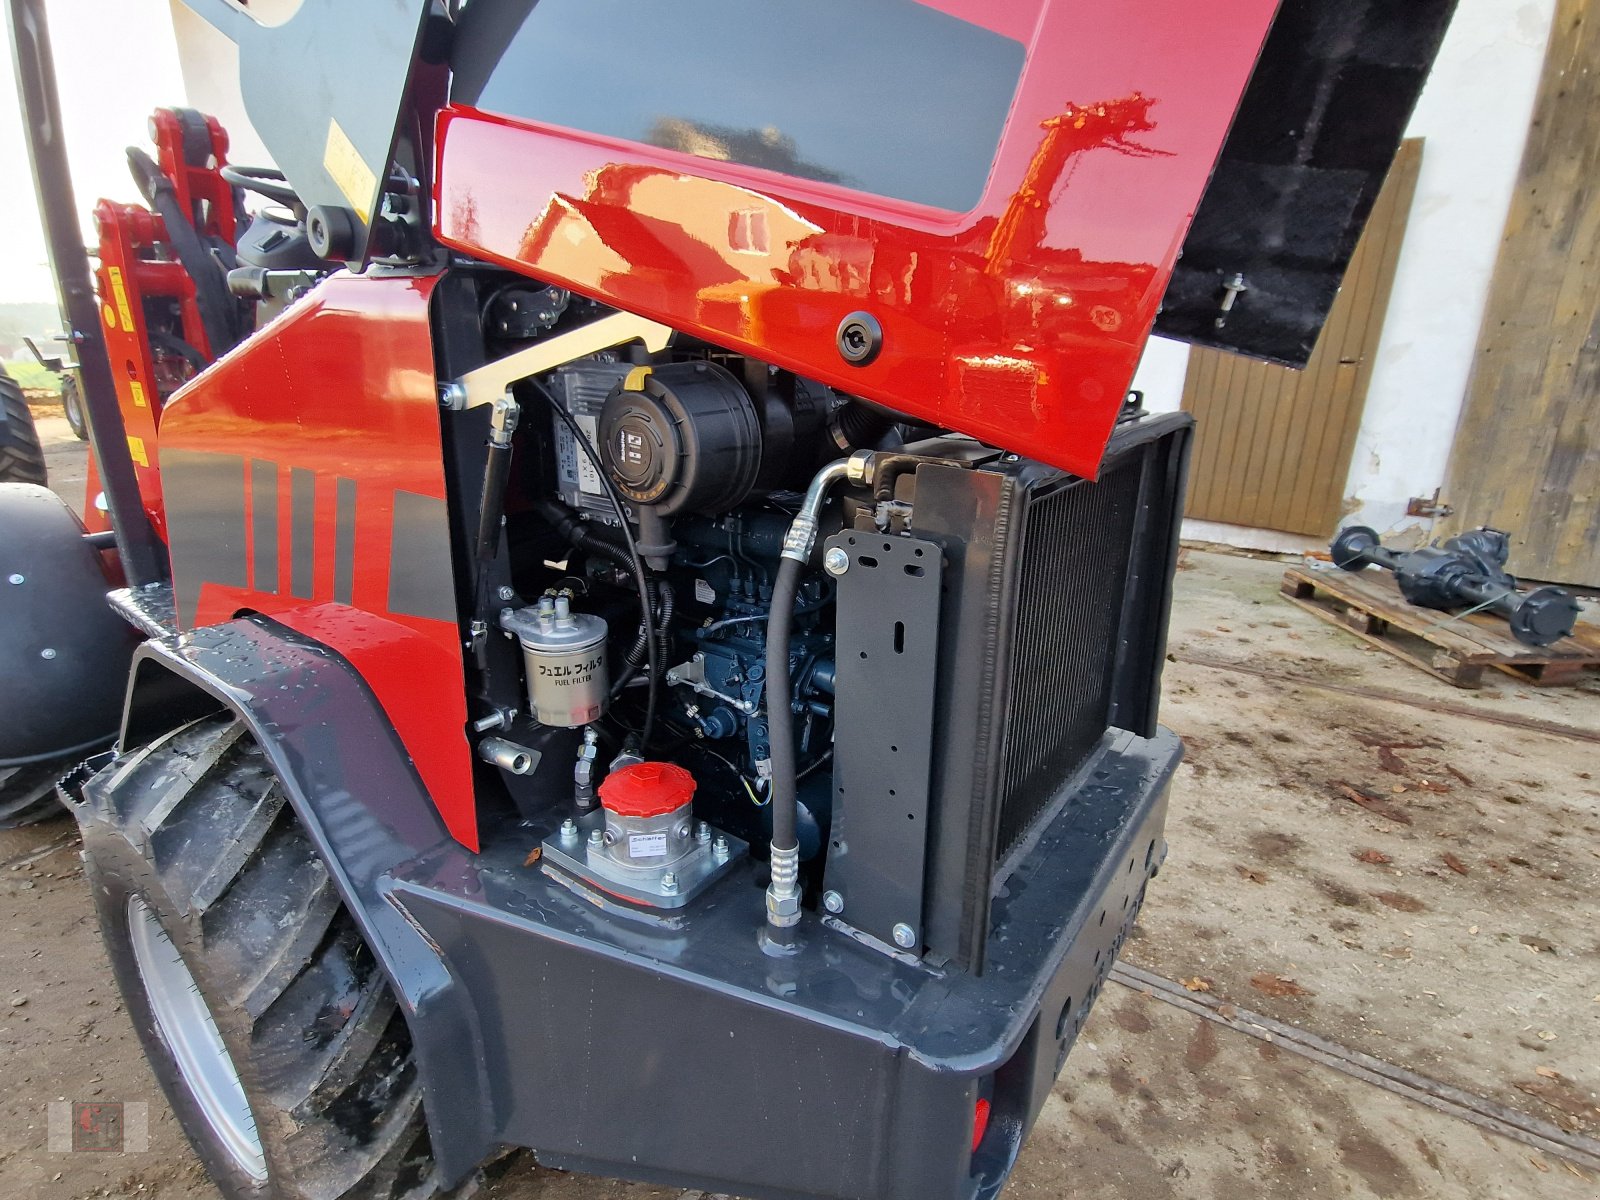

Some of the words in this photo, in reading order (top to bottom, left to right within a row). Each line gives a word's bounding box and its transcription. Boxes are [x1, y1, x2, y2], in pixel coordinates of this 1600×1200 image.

[538, 665, 572, 676] フュエル
[572, 674, 592, 685] FILTER
